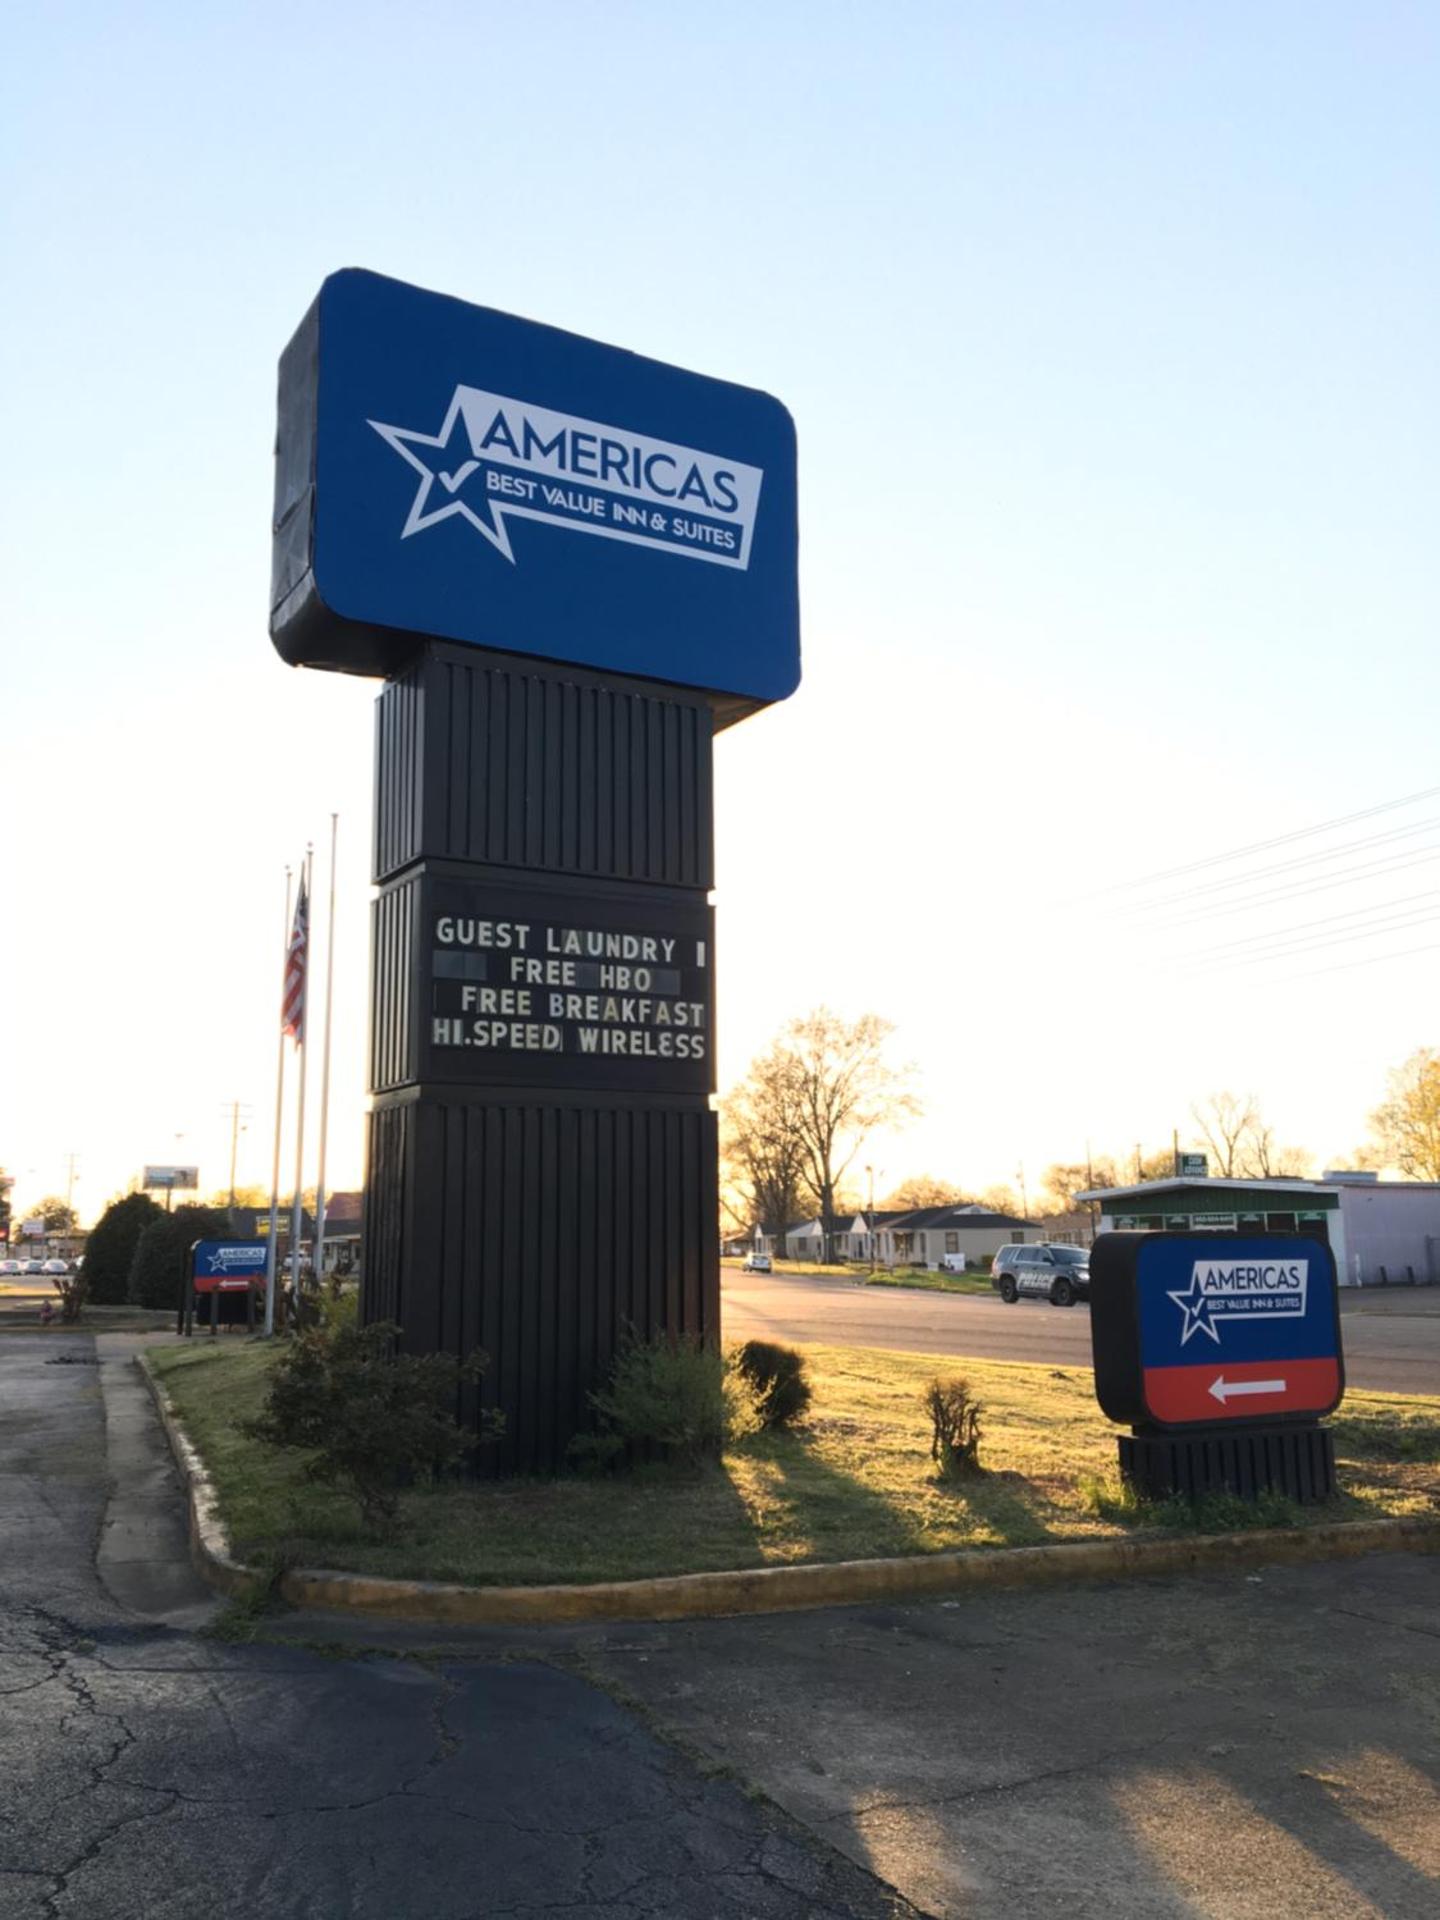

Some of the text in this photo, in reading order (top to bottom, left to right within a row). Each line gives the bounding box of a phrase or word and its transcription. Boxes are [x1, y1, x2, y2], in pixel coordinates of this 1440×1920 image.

[480, 409, 739, 513] AMERICAS
[486, 471, 735, 549] BEST VALUE INN & SUITES
[436, 917, 530, 950] GUEST
[547, 928, 675, 962] LAUNDRY
[510, 957, 651, 992] FREE HBO
[461, 986, 704, 1028] FREE BREAKFAST
[579, 1028, 704, 1058] WIRELESS
[1017, 1272, 1057, 1289] POLICE
[1204, 1266, 1300, 1290] AMERICAS
[1207, 1299, 1225, 1310] BEST
[1226, 1299, 1250, 1309] VALUE
[1252, 1299, 1266, 1308] INN
[1275, 1298, 1300, 1308] SUITES
